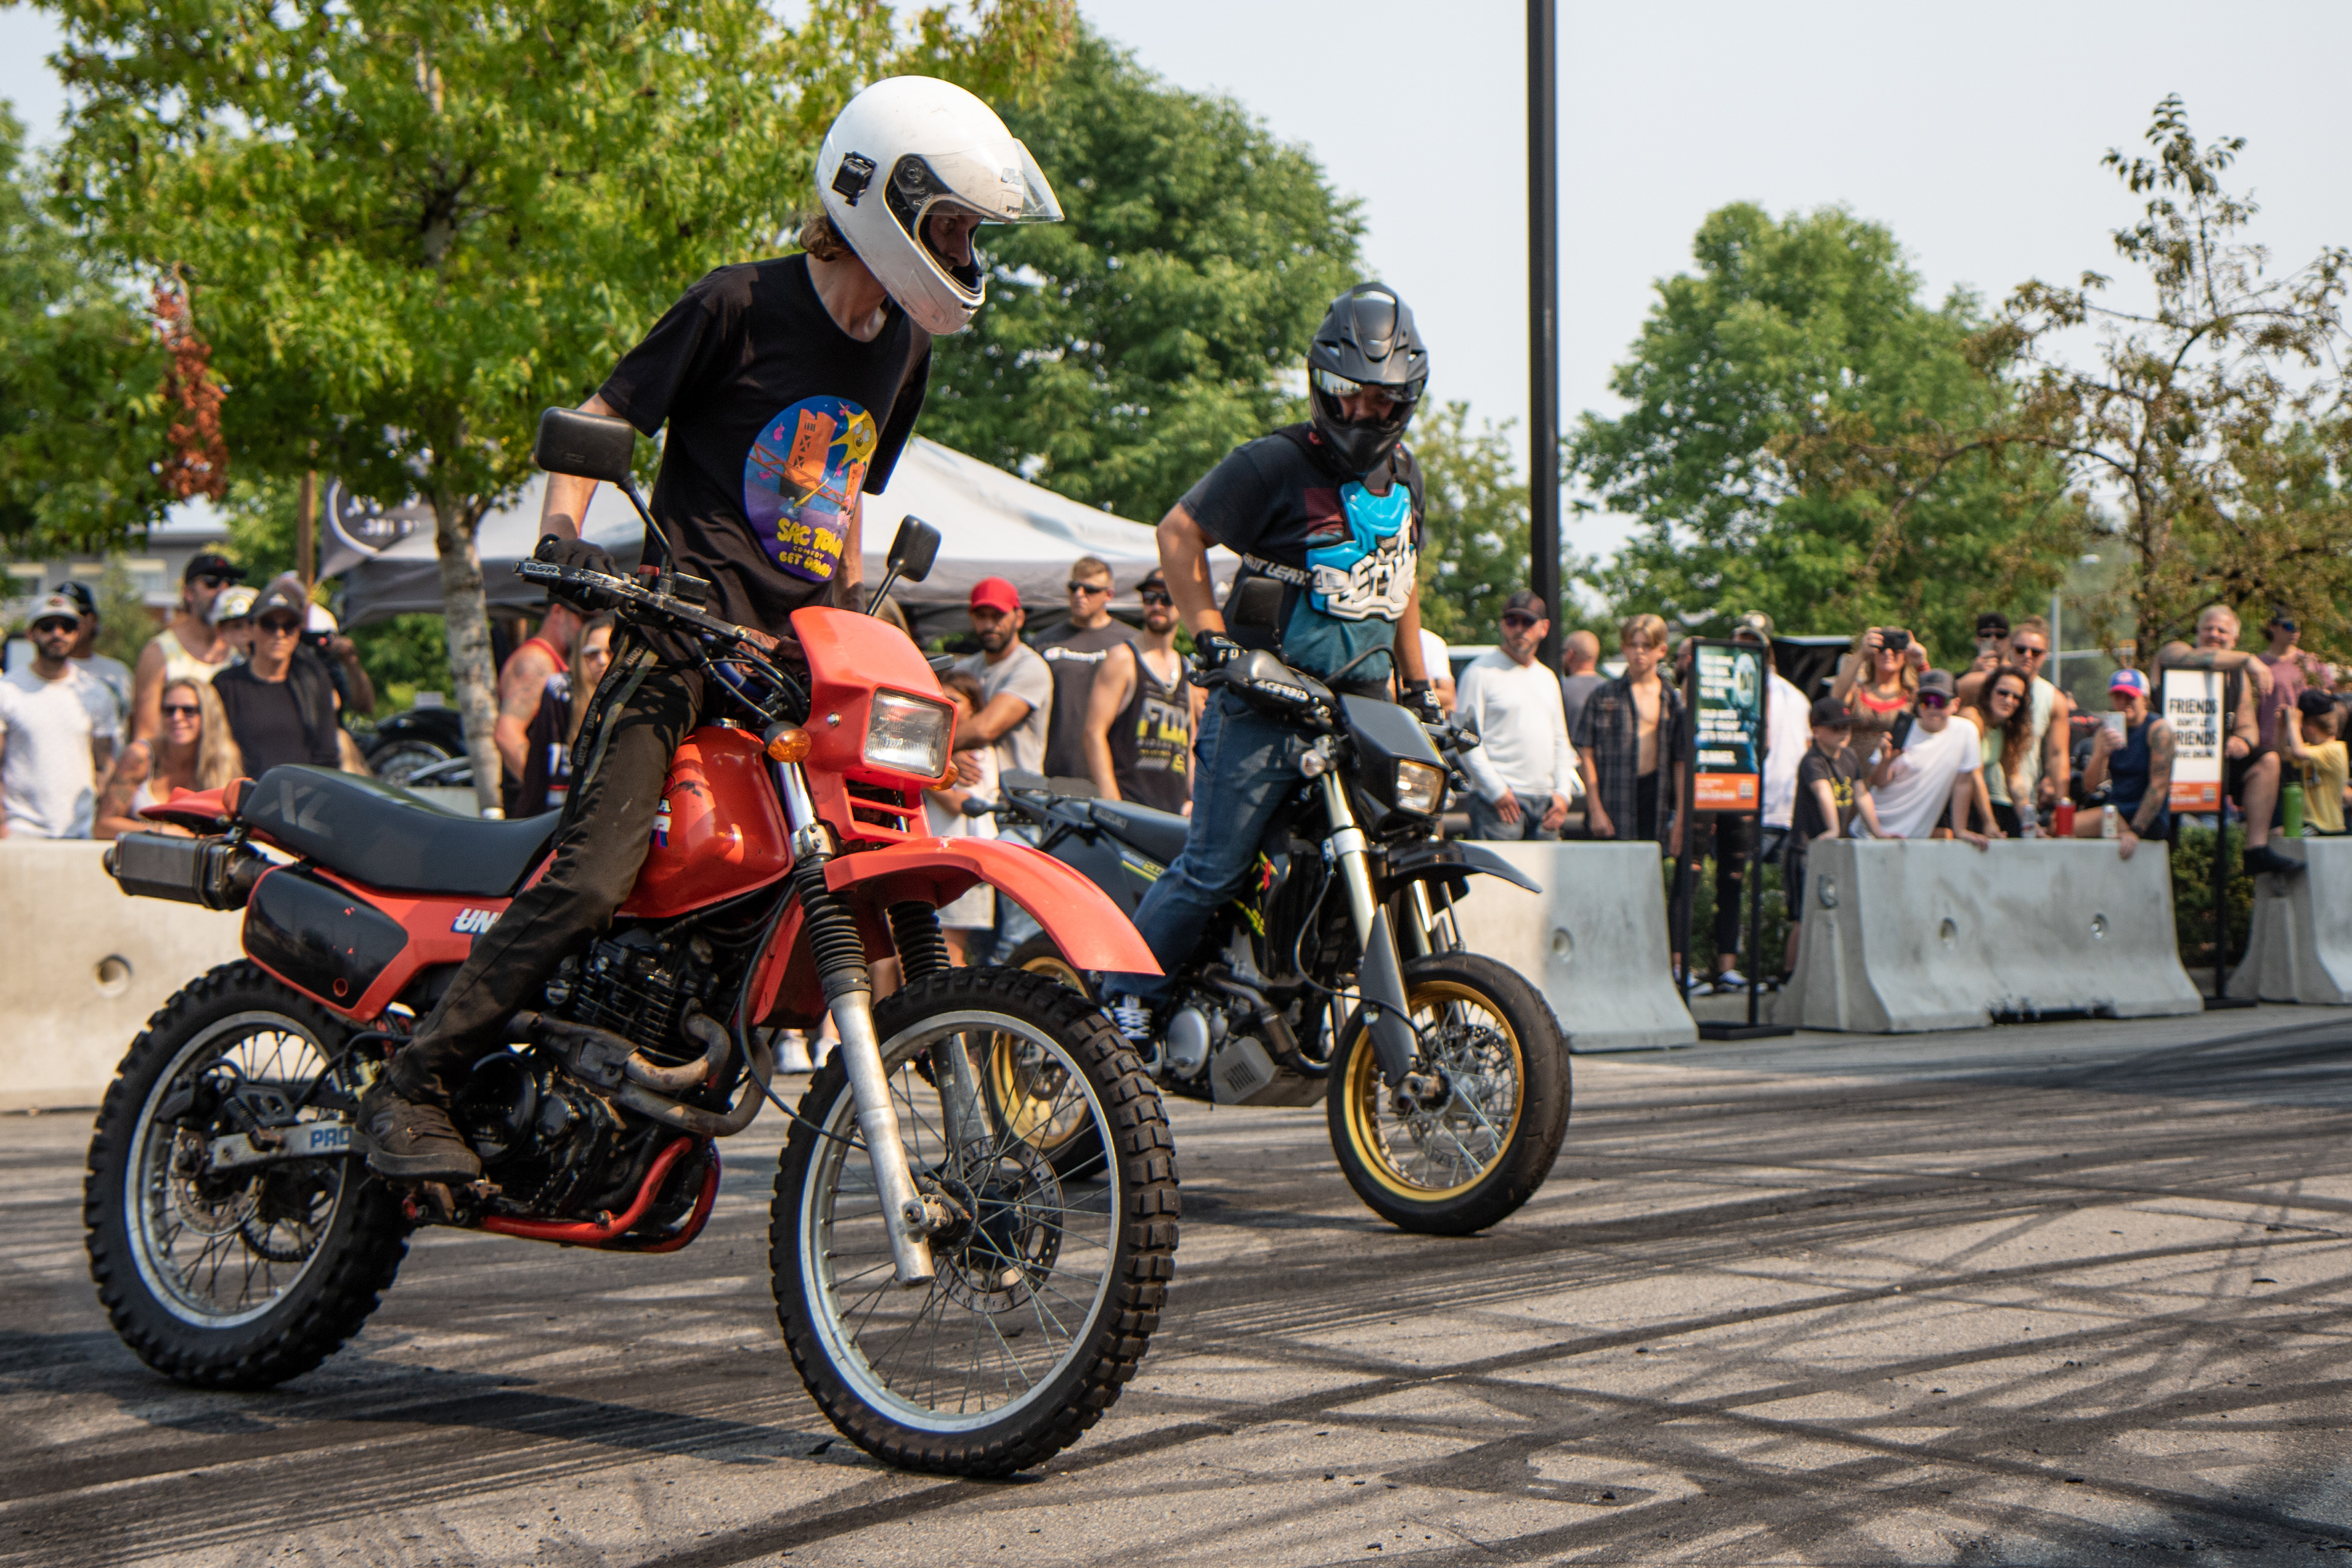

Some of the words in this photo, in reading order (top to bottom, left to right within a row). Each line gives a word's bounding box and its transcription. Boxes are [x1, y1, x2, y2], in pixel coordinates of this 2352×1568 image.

[777, 518, 812, 546] SAC
[779, 551, 803, 565] GET
[804, 556, 832, 578] DOWN
[793, 546, 825, 560] COMEDY
[2169, 698, 2218, 714] FRIENDS
[2176, 729, 2217, 745] RIENDS
[257, 779, 334, 839] XL
[450, 908, 502, 935] UN
[310, 1126, 353, 1149] PRO
